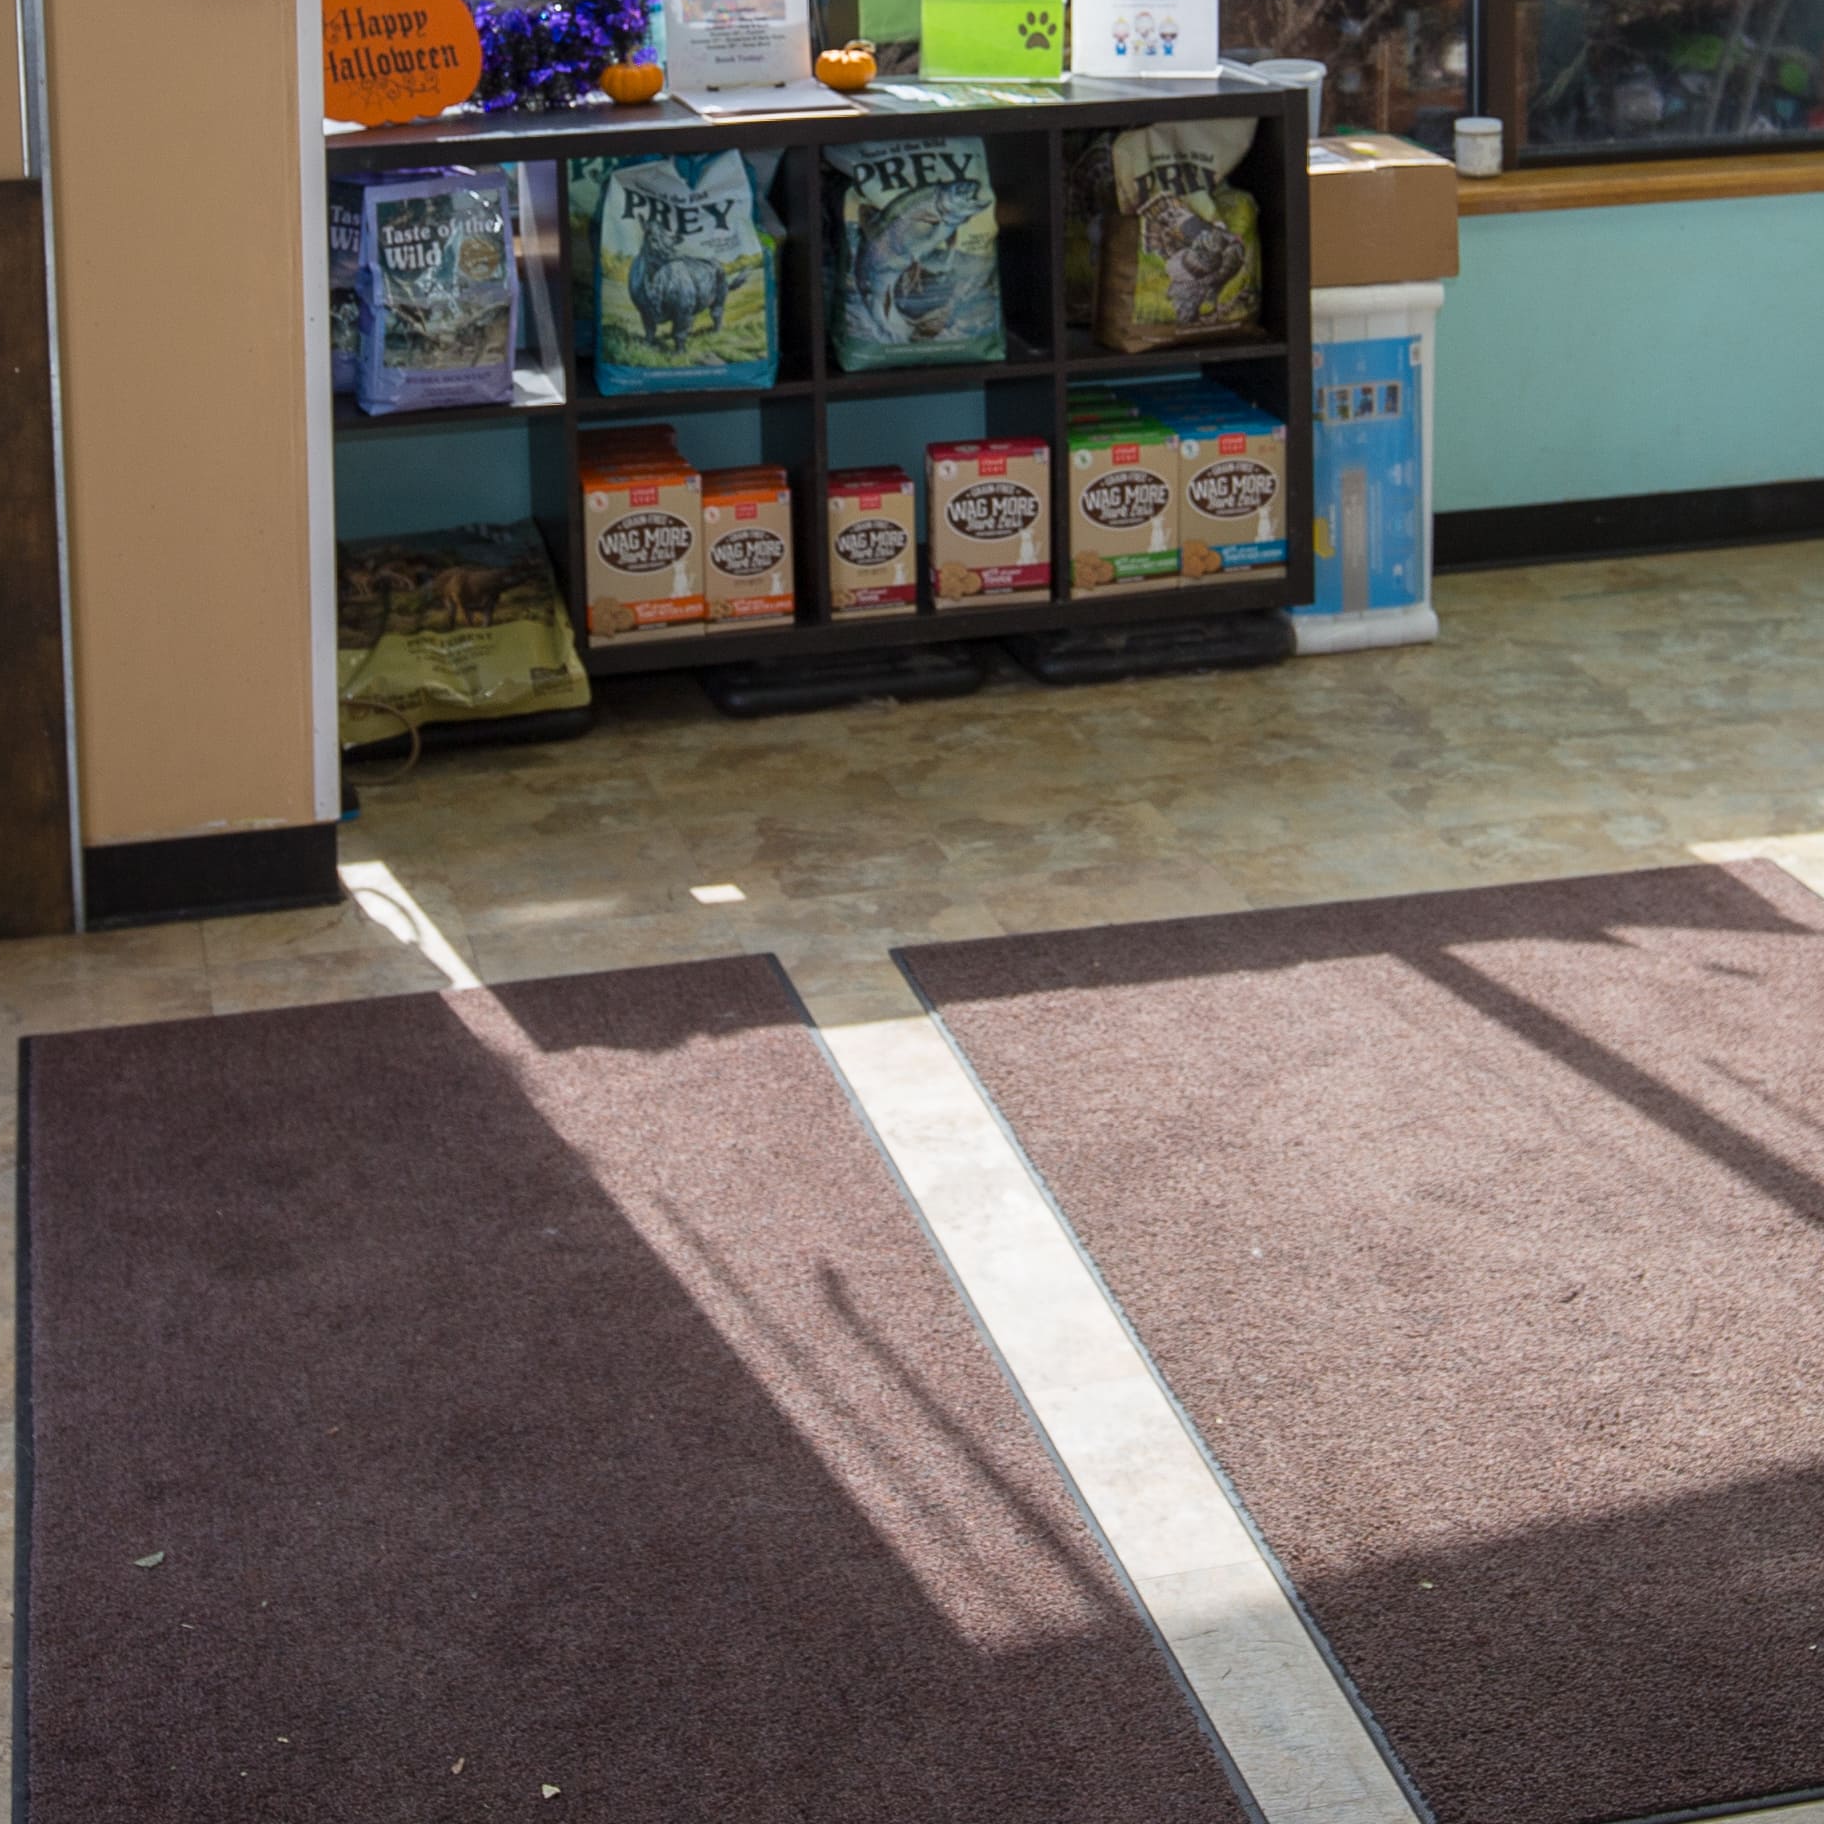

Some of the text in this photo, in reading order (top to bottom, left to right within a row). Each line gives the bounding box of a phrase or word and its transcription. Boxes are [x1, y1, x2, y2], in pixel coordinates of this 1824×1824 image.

[336, 7, 428, 40] Happy
[852, 152, 973, 199] PREY
[621, 187, 736, 238] PREY
[382, 214, 501, 247] Taste of the
[384, 241, 443, 272] Wild
[1084, 485, 1168, 511] WAG MORE
[1190, 474, 1275, 500] WAG MORE
[948, 496, 1040, 522] WAG MORE
[600, 526, 691, 556] WAG MORE
[712, 540, 784, 564] WAG MORE
[837, 530, 907, 553] WAG MORE
